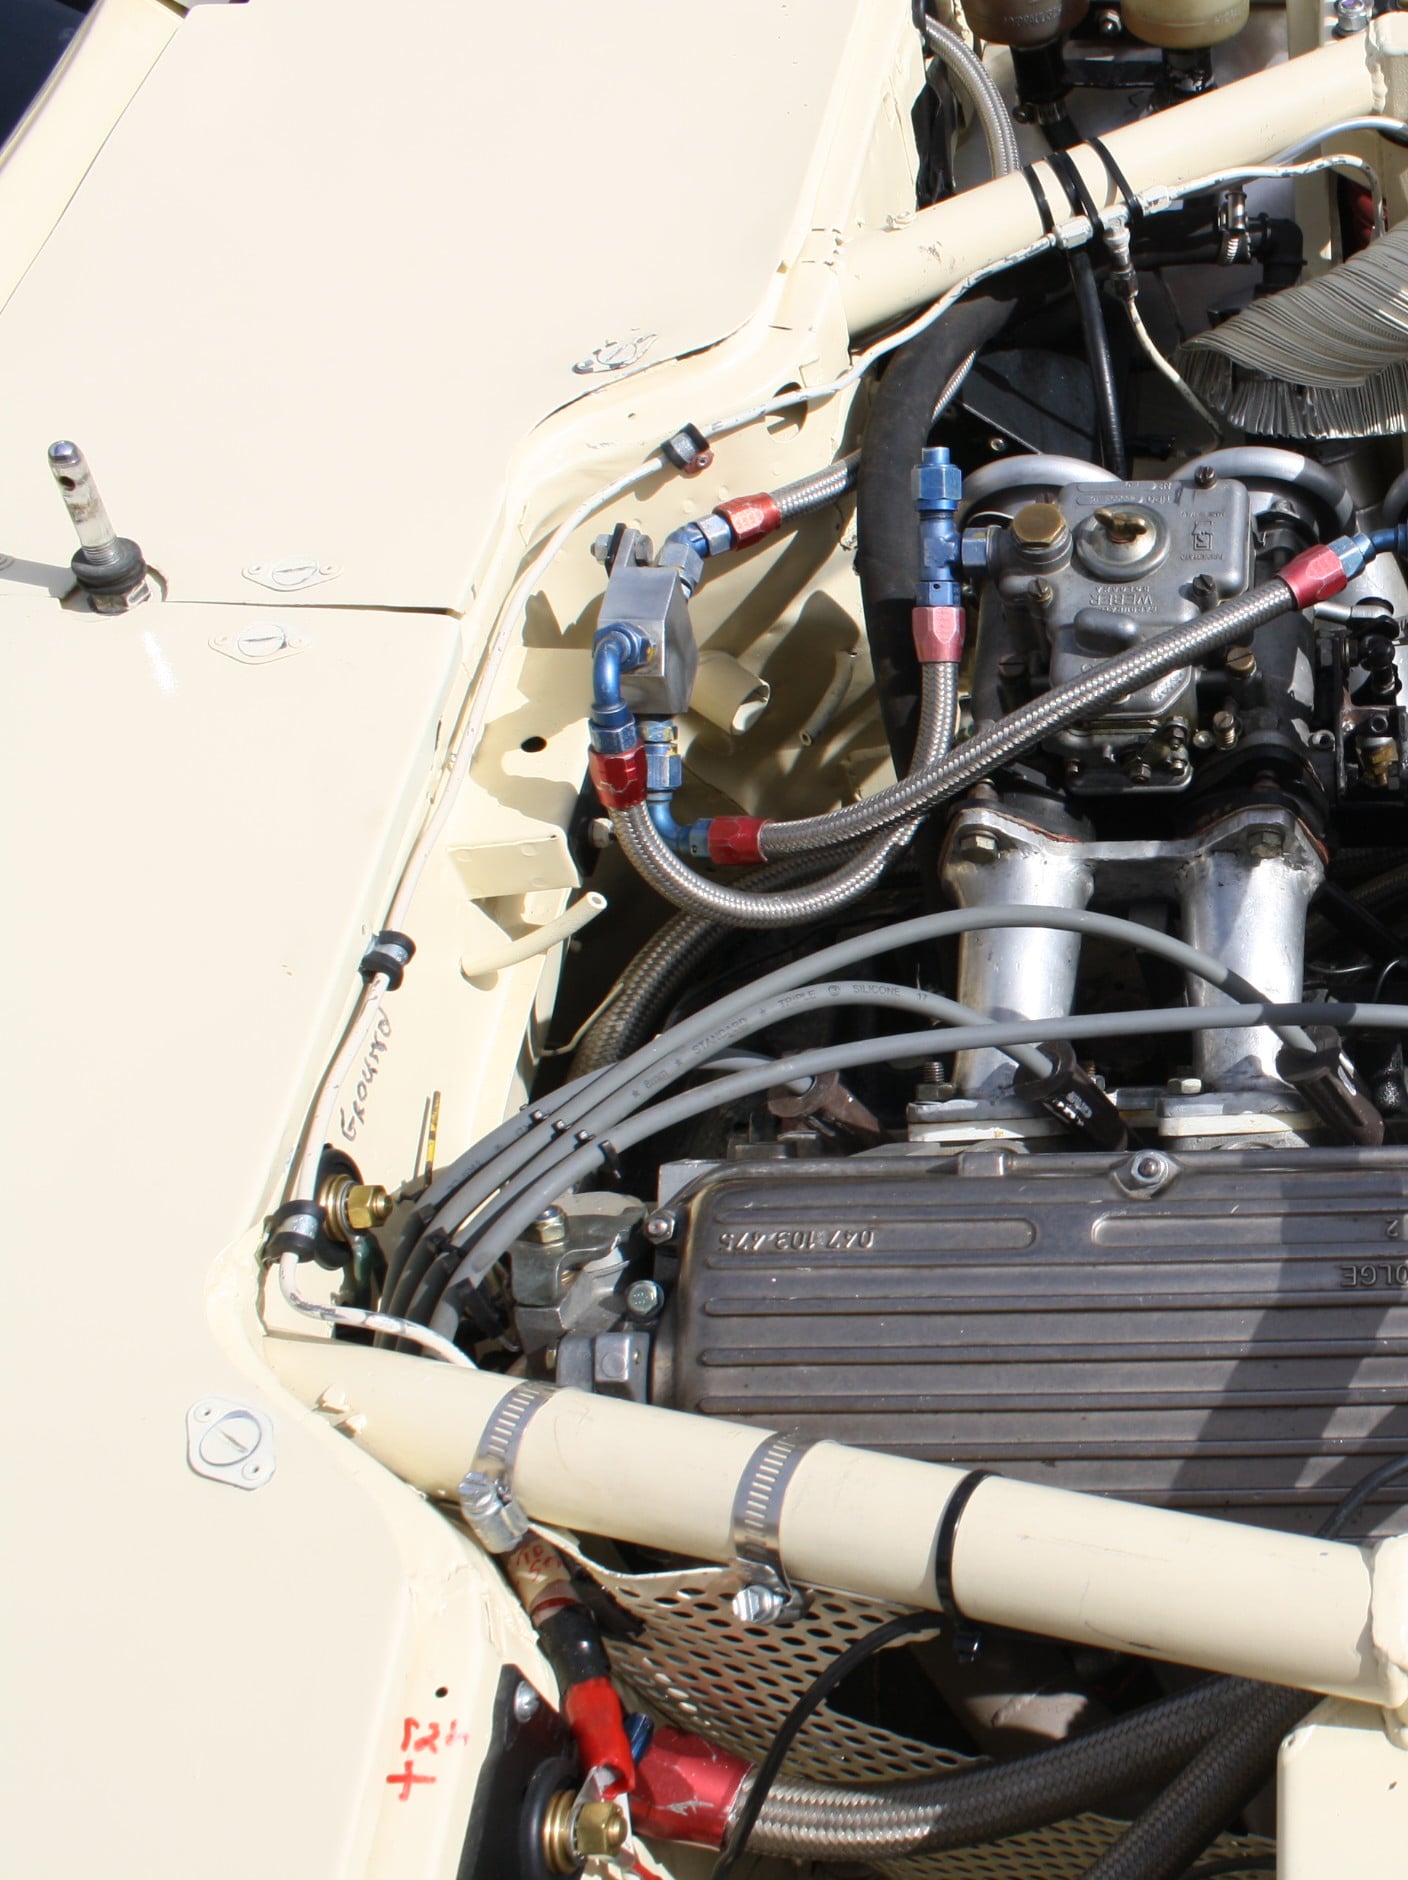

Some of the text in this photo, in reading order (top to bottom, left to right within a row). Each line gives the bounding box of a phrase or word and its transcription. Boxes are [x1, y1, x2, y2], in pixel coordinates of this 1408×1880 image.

[1089, 594, 1153, 606] WEBER
[691, 1017, 749, 1055] STANDARD
[852, 983, 901, 997] SILICONE
